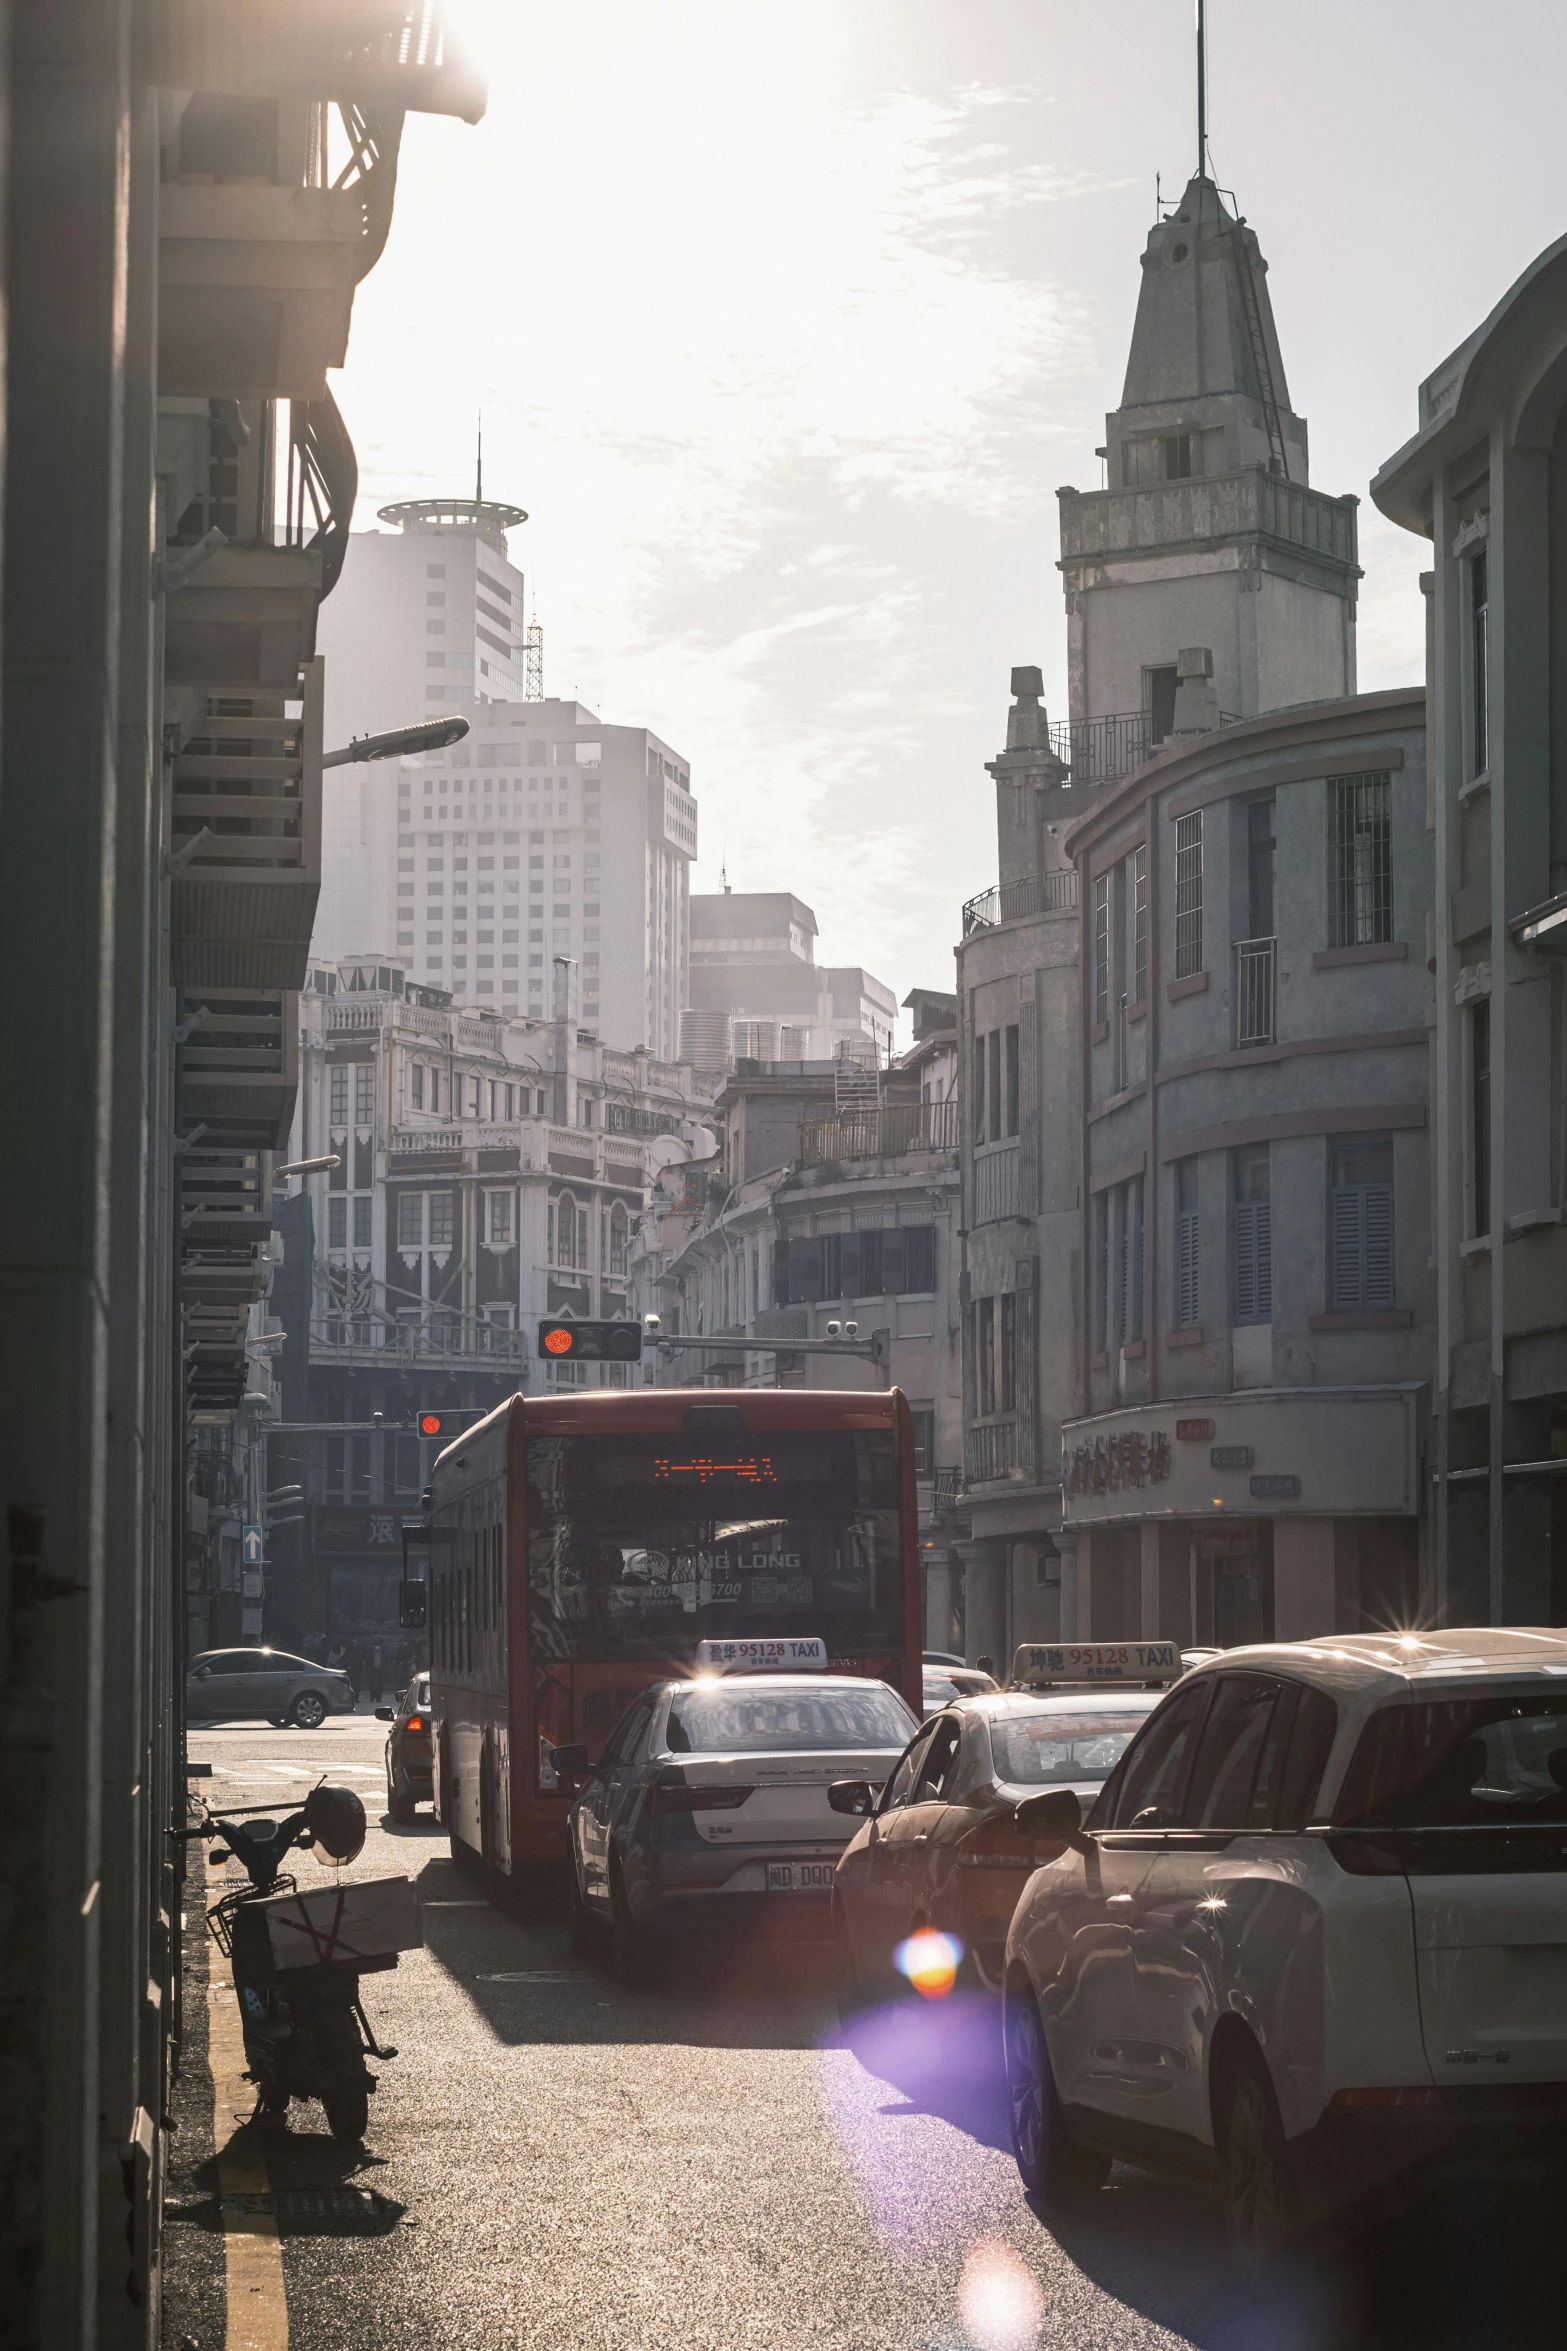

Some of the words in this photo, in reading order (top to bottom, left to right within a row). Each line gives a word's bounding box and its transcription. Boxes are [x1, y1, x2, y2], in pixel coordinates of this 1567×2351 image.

[677, 1554, 730, 1570] KING
[738, 1553, 801, 1569] LONG
[710, 1644, 736, 1662] 盈华
[739, 1643, 785, 1657] 95128
[789, 1642, 820, 1657] TAXI
[1069, 1647, 1129, 1665] 95128
[1135, 1647, 1174, 1667] TAXI
[750, 1657, 780, 1665] 召车热线
[1086, 1666, 1123, 1677] 召车热线
